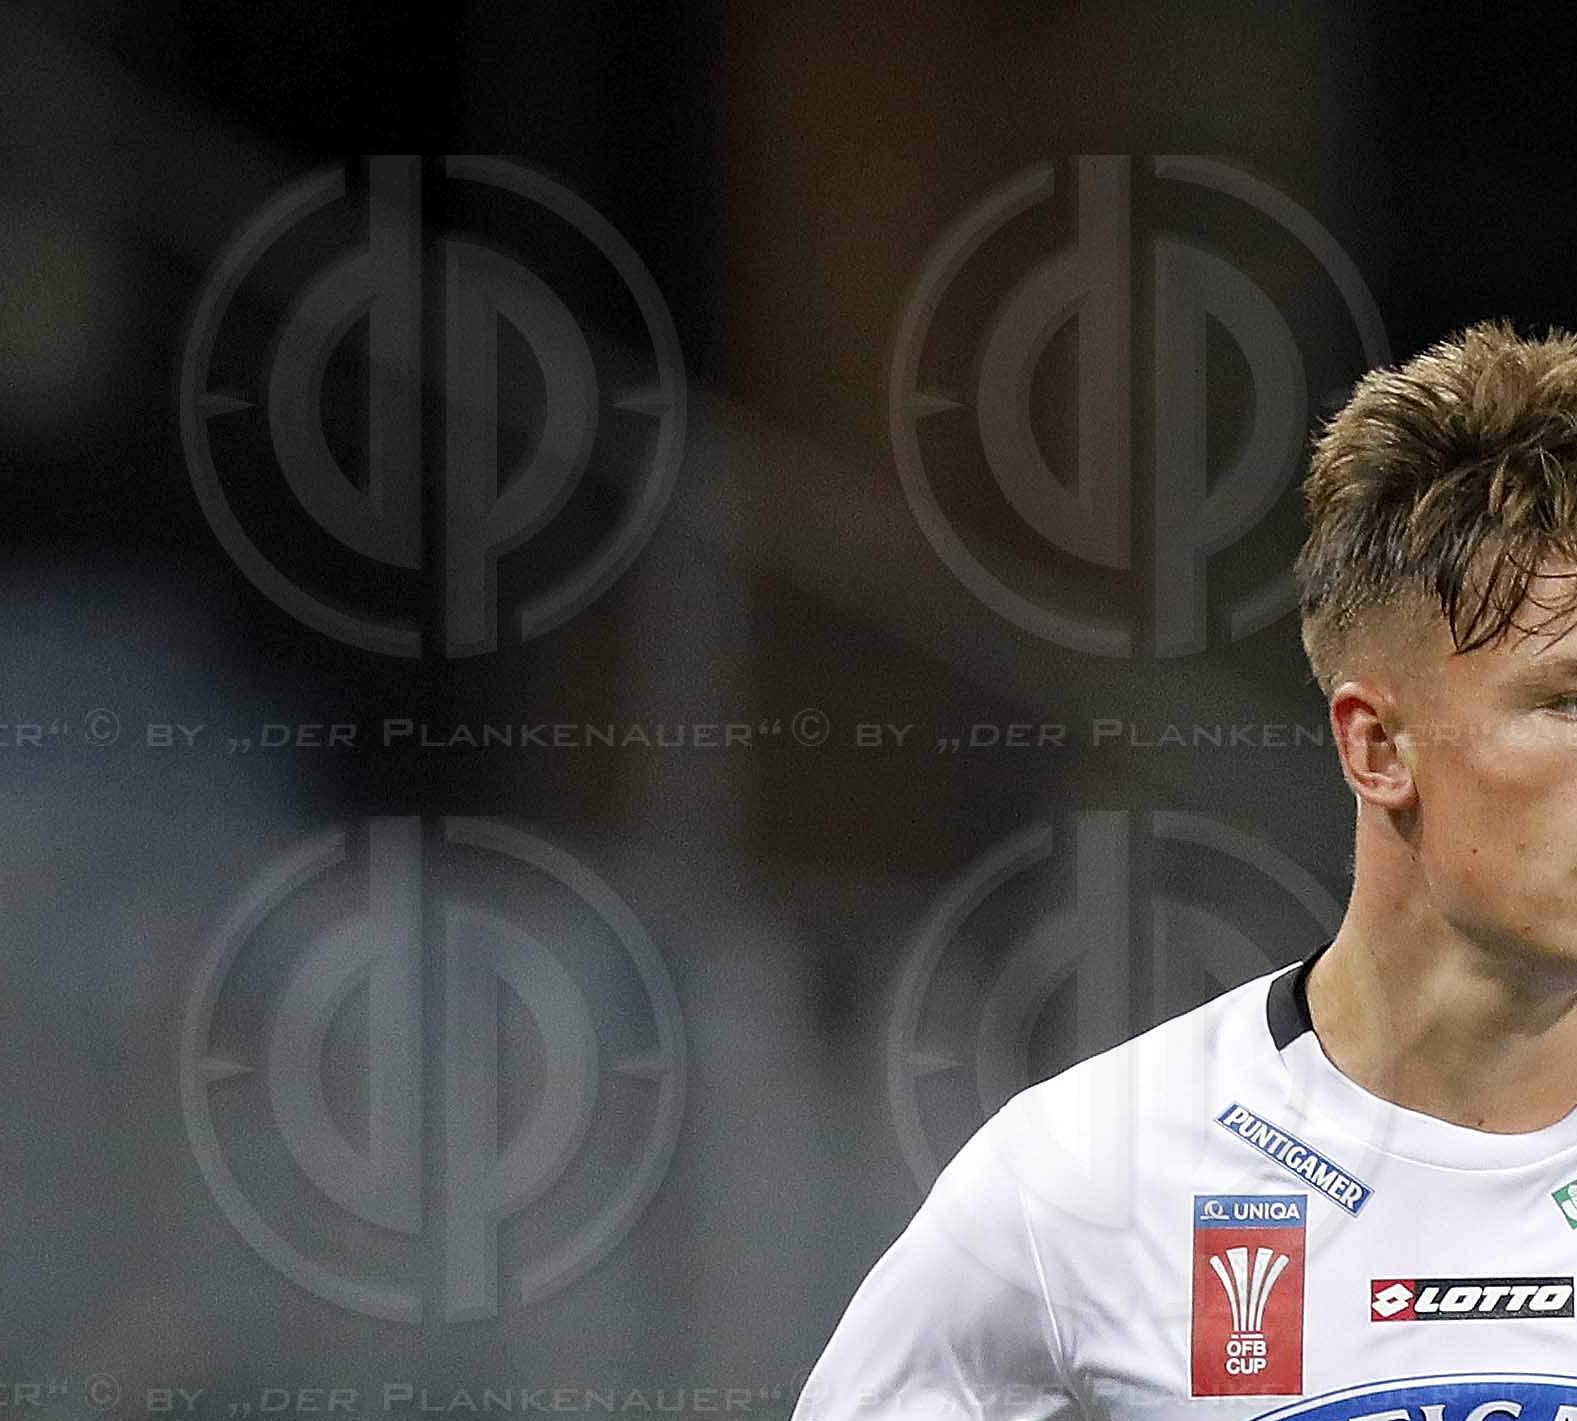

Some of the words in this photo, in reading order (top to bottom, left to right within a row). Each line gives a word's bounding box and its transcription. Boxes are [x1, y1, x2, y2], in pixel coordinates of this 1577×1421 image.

[1223, 1106, 1364, 1208] PUNTIGAMER
[1233, 1202, 1301, 1220] UNIQA
[1414, 1284, 1573, 1313] LOTTO
[1225, 1357, 1267, 1375] CUP
